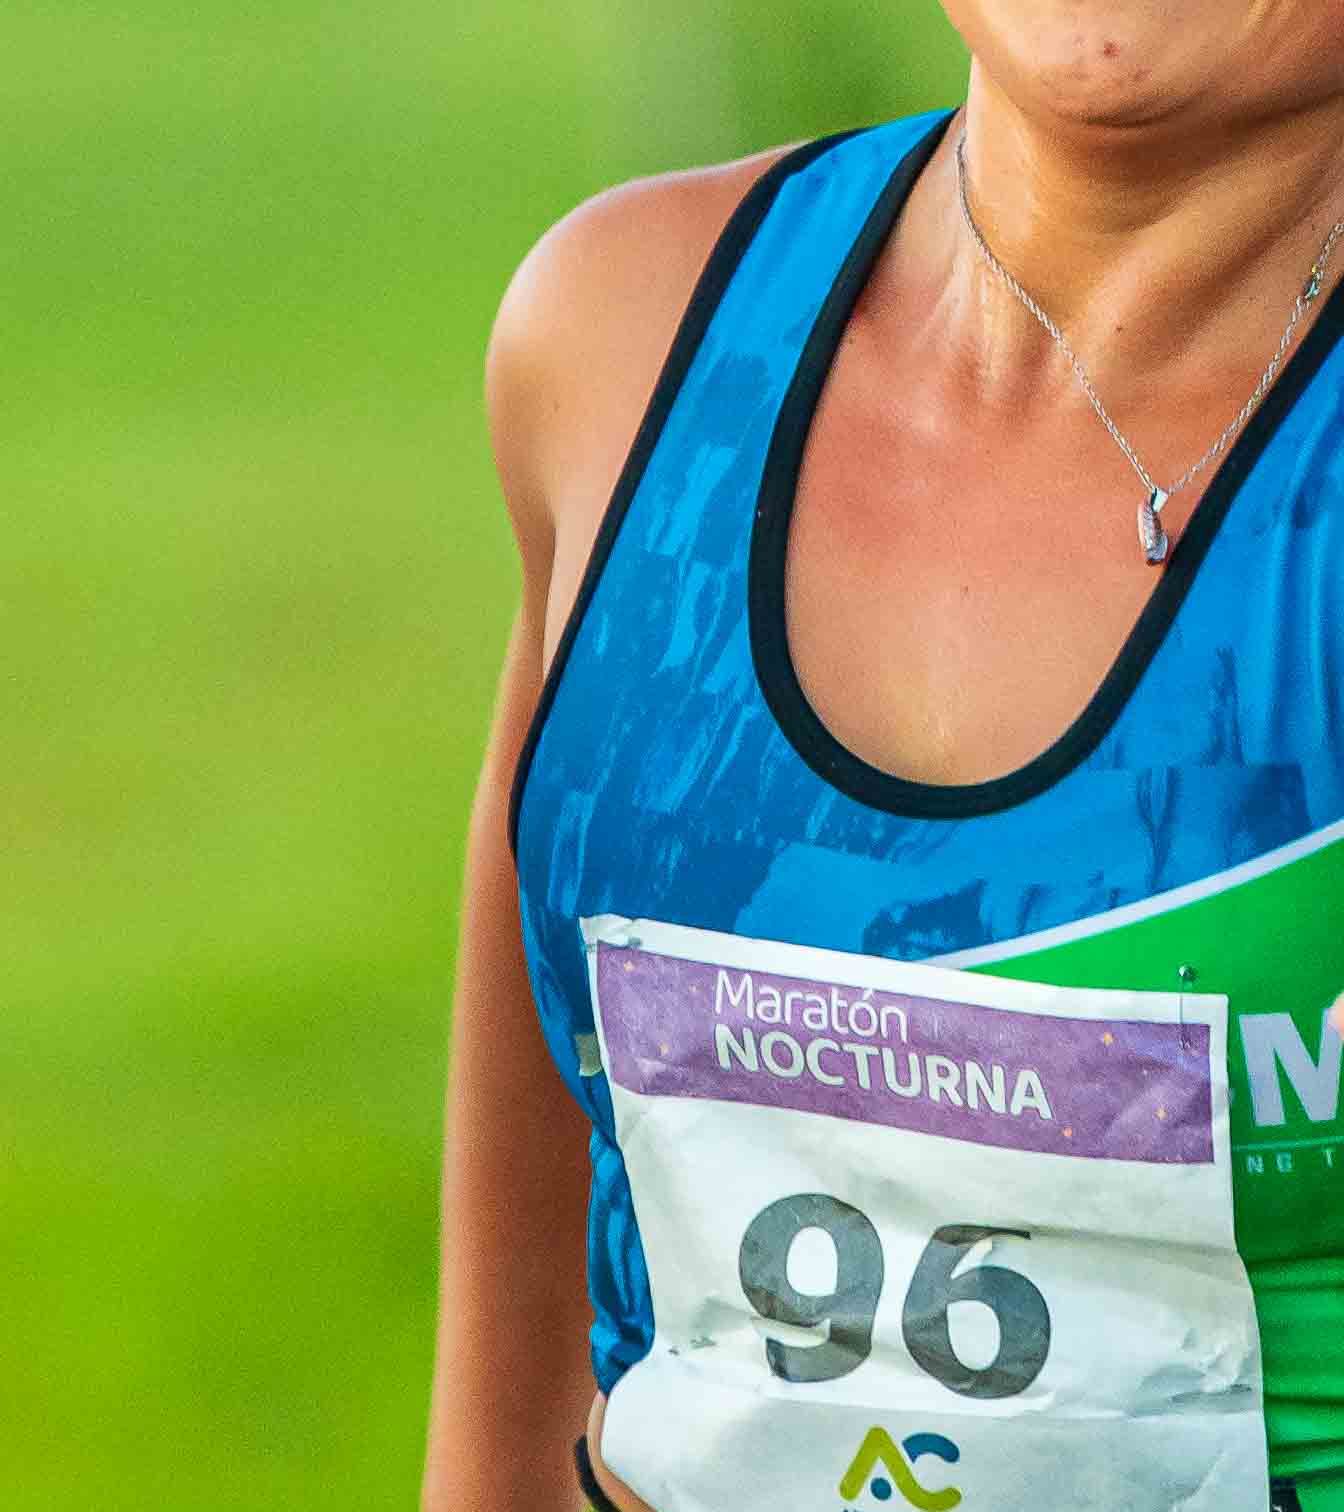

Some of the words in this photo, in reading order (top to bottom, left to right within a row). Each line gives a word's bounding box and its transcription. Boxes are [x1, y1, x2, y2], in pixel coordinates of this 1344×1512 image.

[713, 969, 908, 1043] Maratón
[713, 1023, 1054, 1121] NOCTURNA
[738, 1192, 1052, 1400] 96
